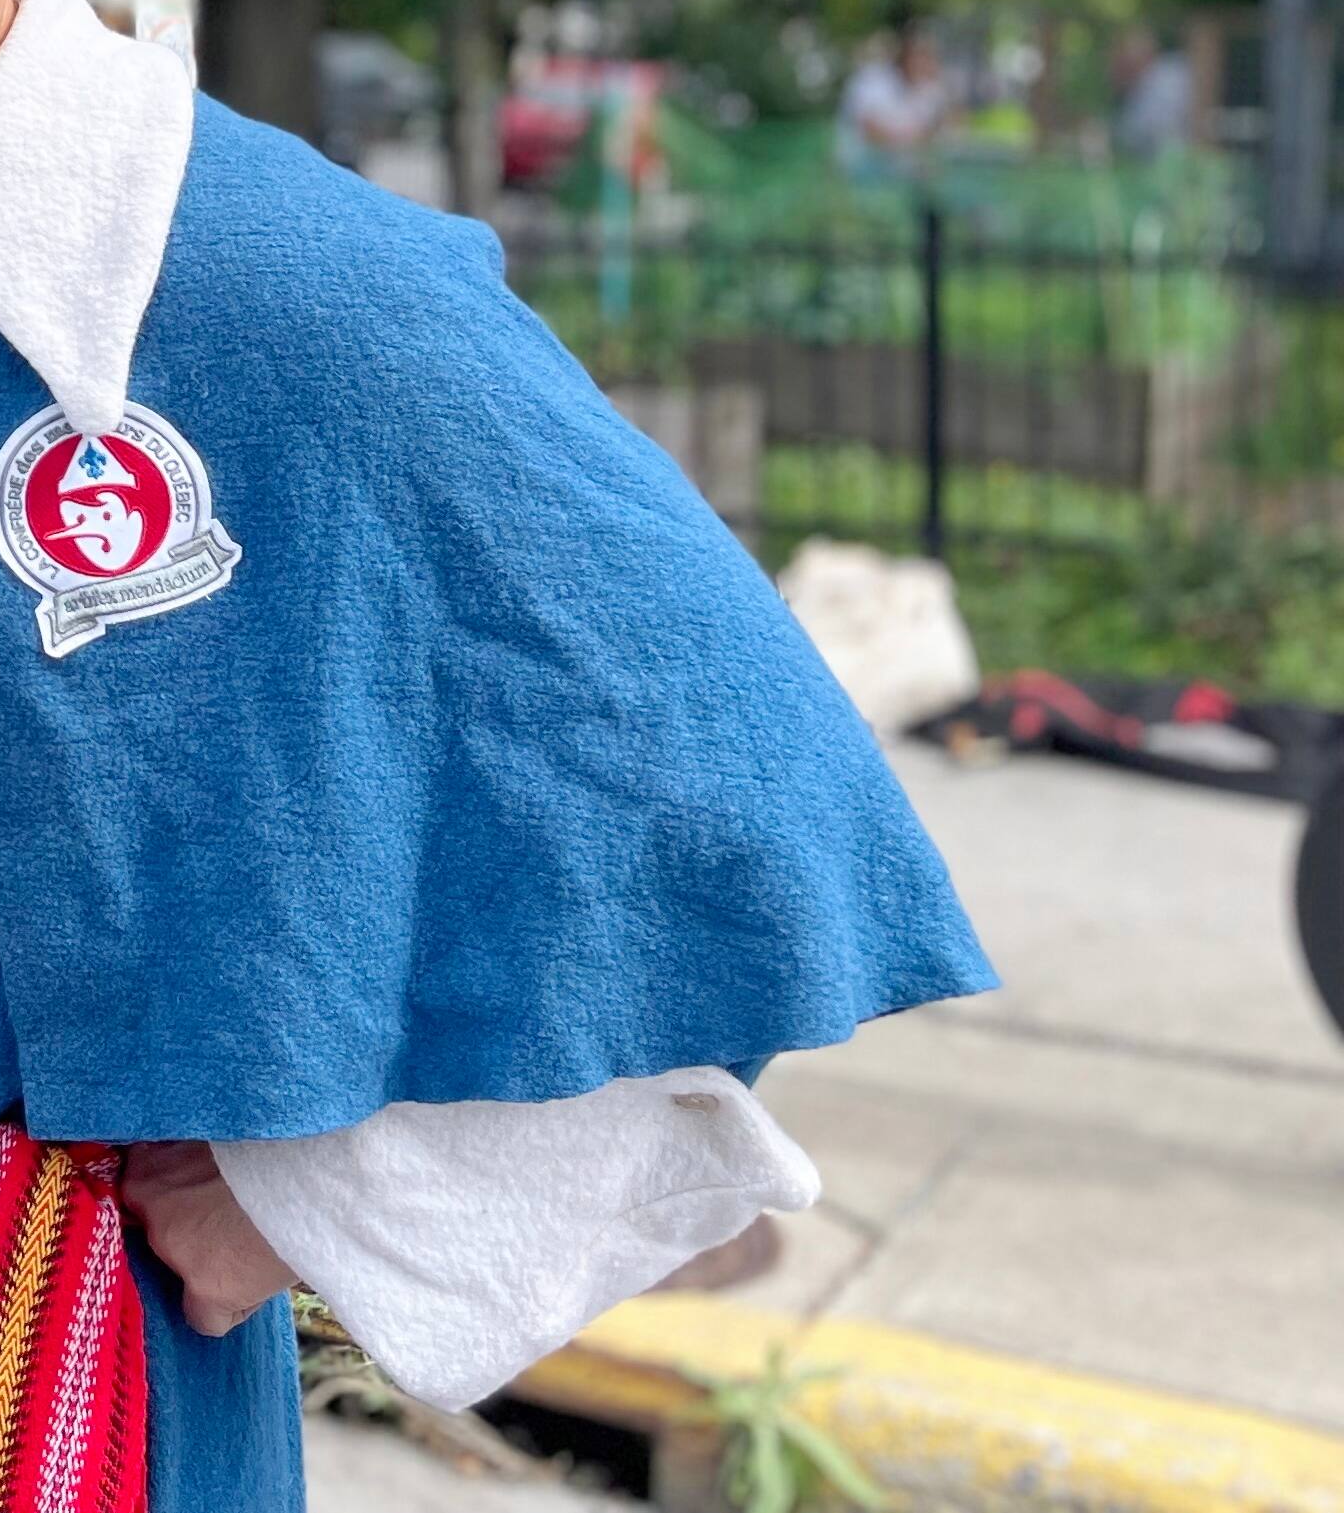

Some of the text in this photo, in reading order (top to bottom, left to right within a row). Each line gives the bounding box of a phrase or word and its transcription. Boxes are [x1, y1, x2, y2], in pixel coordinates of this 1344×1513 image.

[39, 557, 61, 580] LA
[145, 437, 170, 460] DU
[163, 459, 192, 524] QUÉBEC
